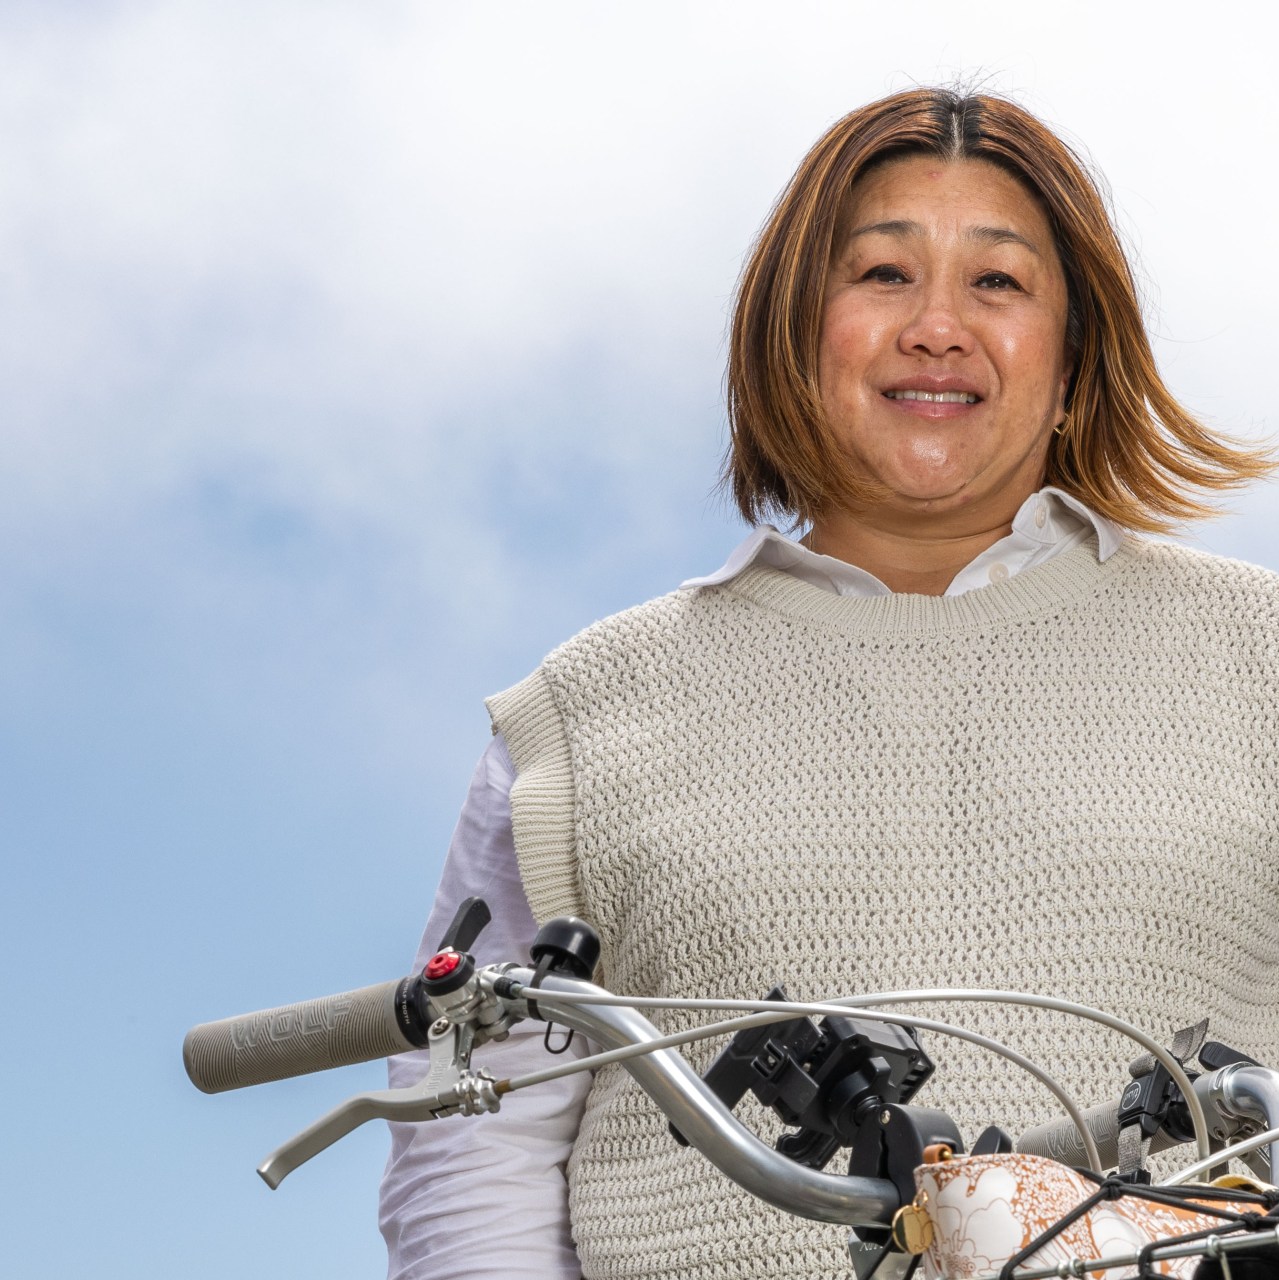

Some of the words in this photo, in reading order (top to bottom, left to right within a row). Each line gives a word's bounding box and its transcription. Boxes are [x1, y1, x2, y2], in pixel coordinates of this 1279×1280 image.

[230, 999, 352, 1050] WOLF
[401, 1001, 410, 1025] TOOTH
[1045, 1109, 1120, 1158] WOL
